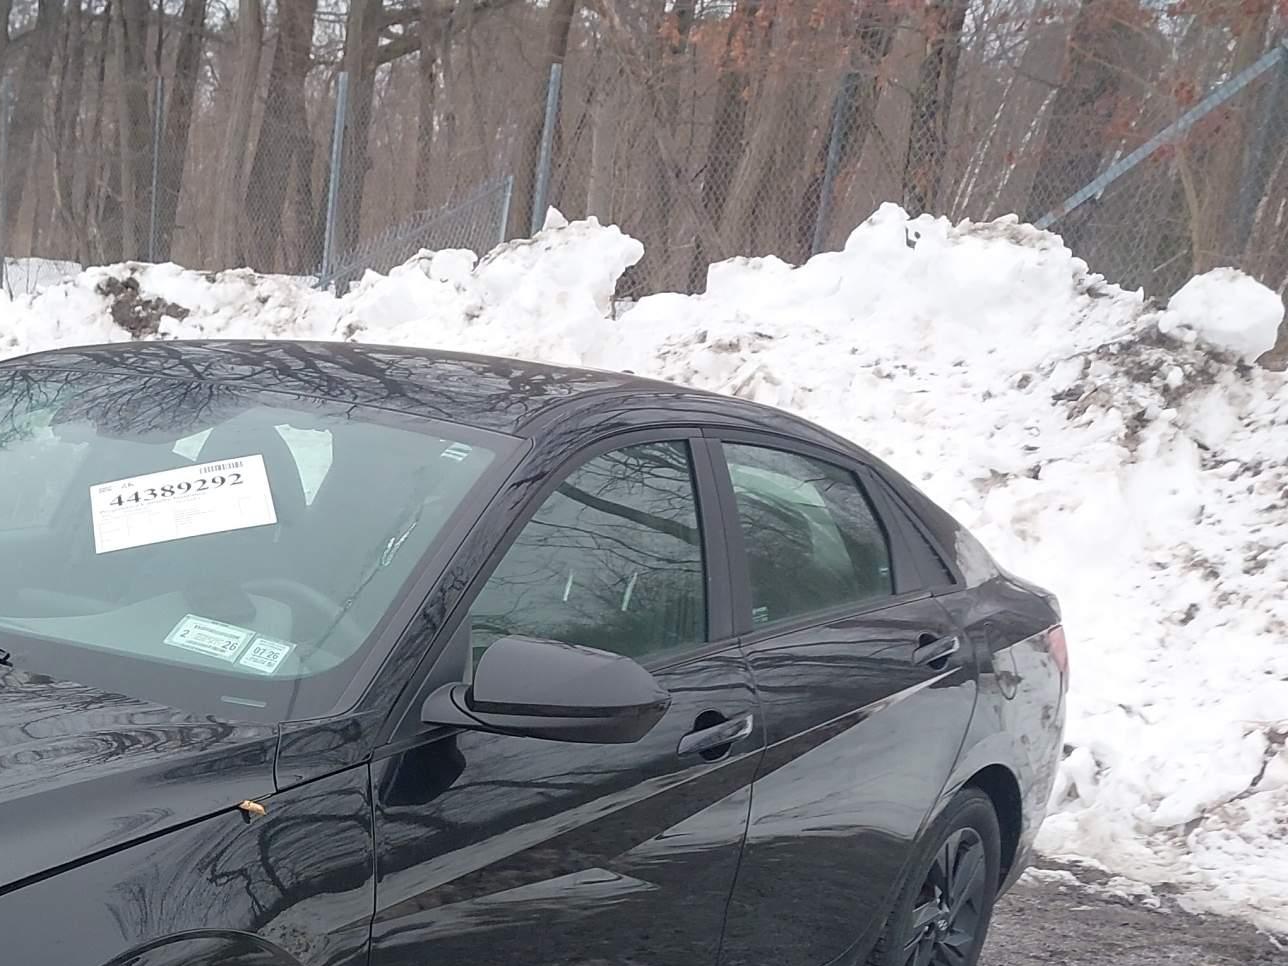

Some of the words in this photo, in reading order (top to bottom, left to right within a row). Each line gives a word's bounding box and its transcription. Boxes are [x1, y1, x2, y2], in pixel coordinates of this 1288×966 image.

[110, 473, 245, 507] 44389292
[180, 629, 190, 639] 2
[222, 640, 238, 651] 26
[266, 650, 280, 660] 26
